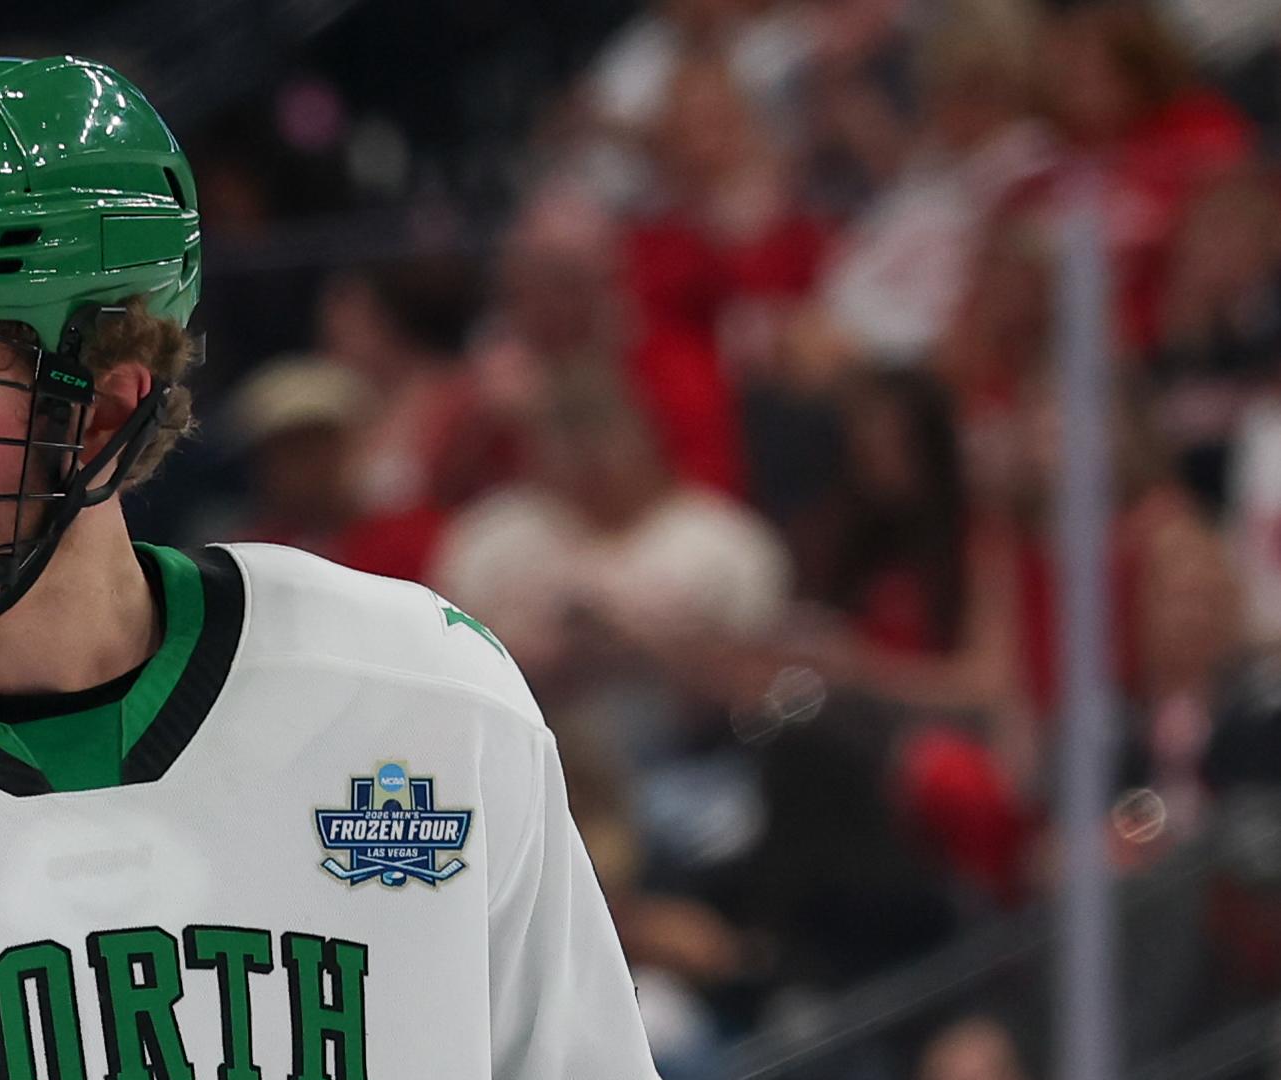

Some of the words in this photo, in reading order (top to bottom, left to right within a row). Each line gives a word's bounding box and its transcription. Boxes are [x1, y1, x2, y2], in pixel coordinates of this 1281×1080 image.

[50, 370, 88, 388] CCM
[365, 811, 389, 820] 2026
[391, 811, 420, 820] MEN'S
[329, 819, 404, 841] FROZEN
[407, 819, 459, 841] FOUR
[366, 848, 385, 858] LAS
[387, 848, 419, 858] VEGAS
